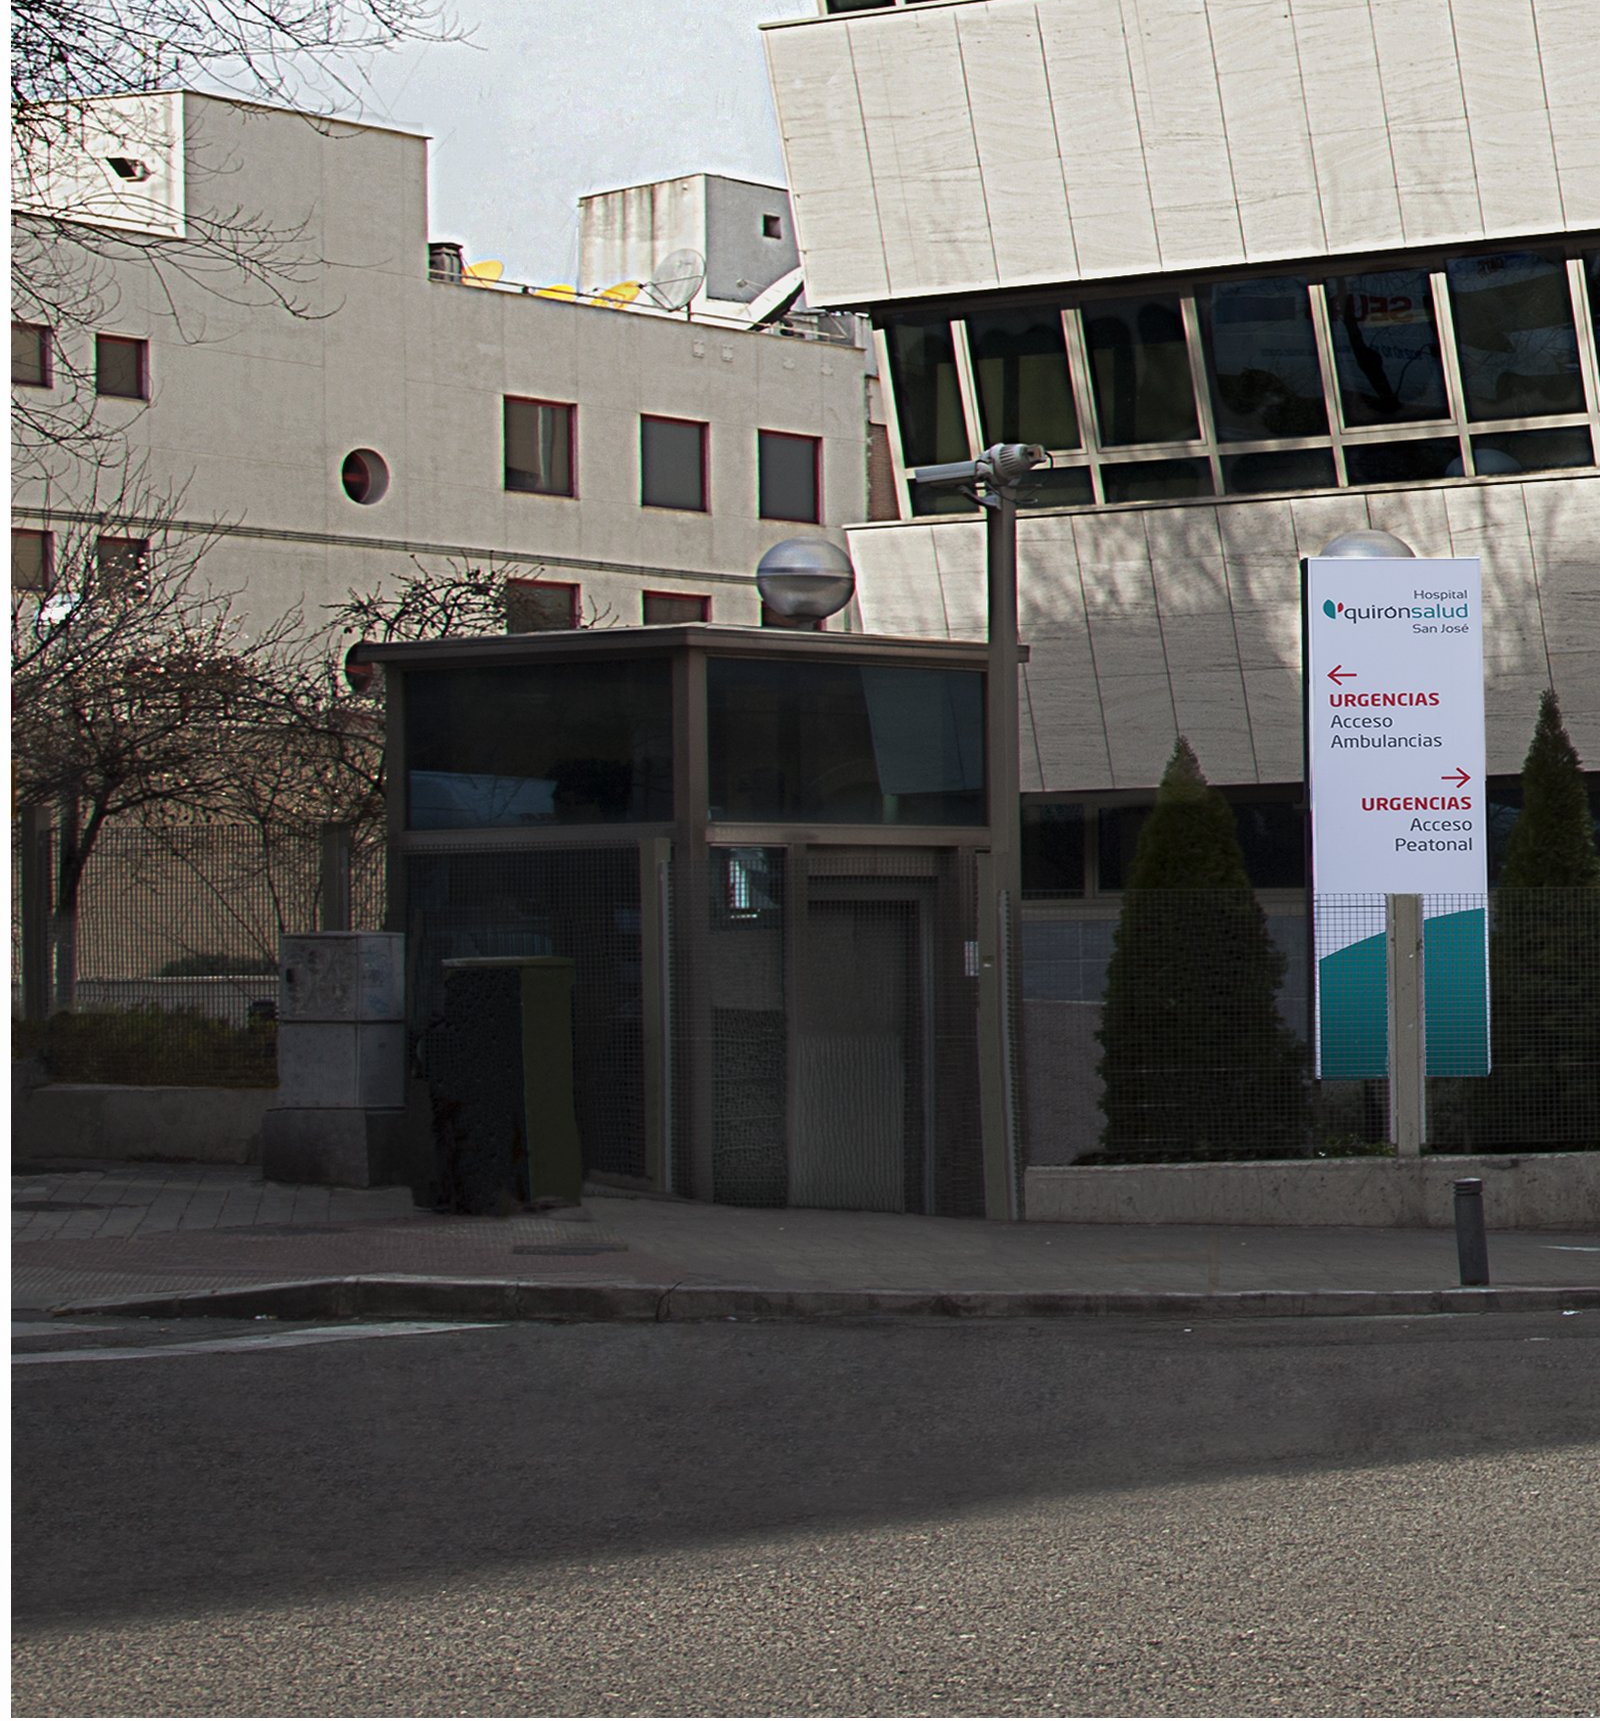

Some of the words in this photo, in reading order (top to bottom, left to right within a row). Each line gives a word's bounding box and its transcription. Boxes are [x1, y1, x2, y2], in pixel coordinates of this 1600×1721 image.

[1413, 589, 1468, 601] Hospital
[1343, 603, 1469, 624] quirónsalud
[1412, 623, 1438, 634] San
[1440, 622, 1469, 634] José
[1328, 692, 1440, 708] URGENCIAS
[1330, 714, 1393, 729] Acceso
[1330, 734, 1443, 749] Ambulancias
[1361, 796, 1472, 811] URGENCIAS
[1410, 818, 1473, 832] Acceso
[1395, 837, 1473, 852] Peatonal
